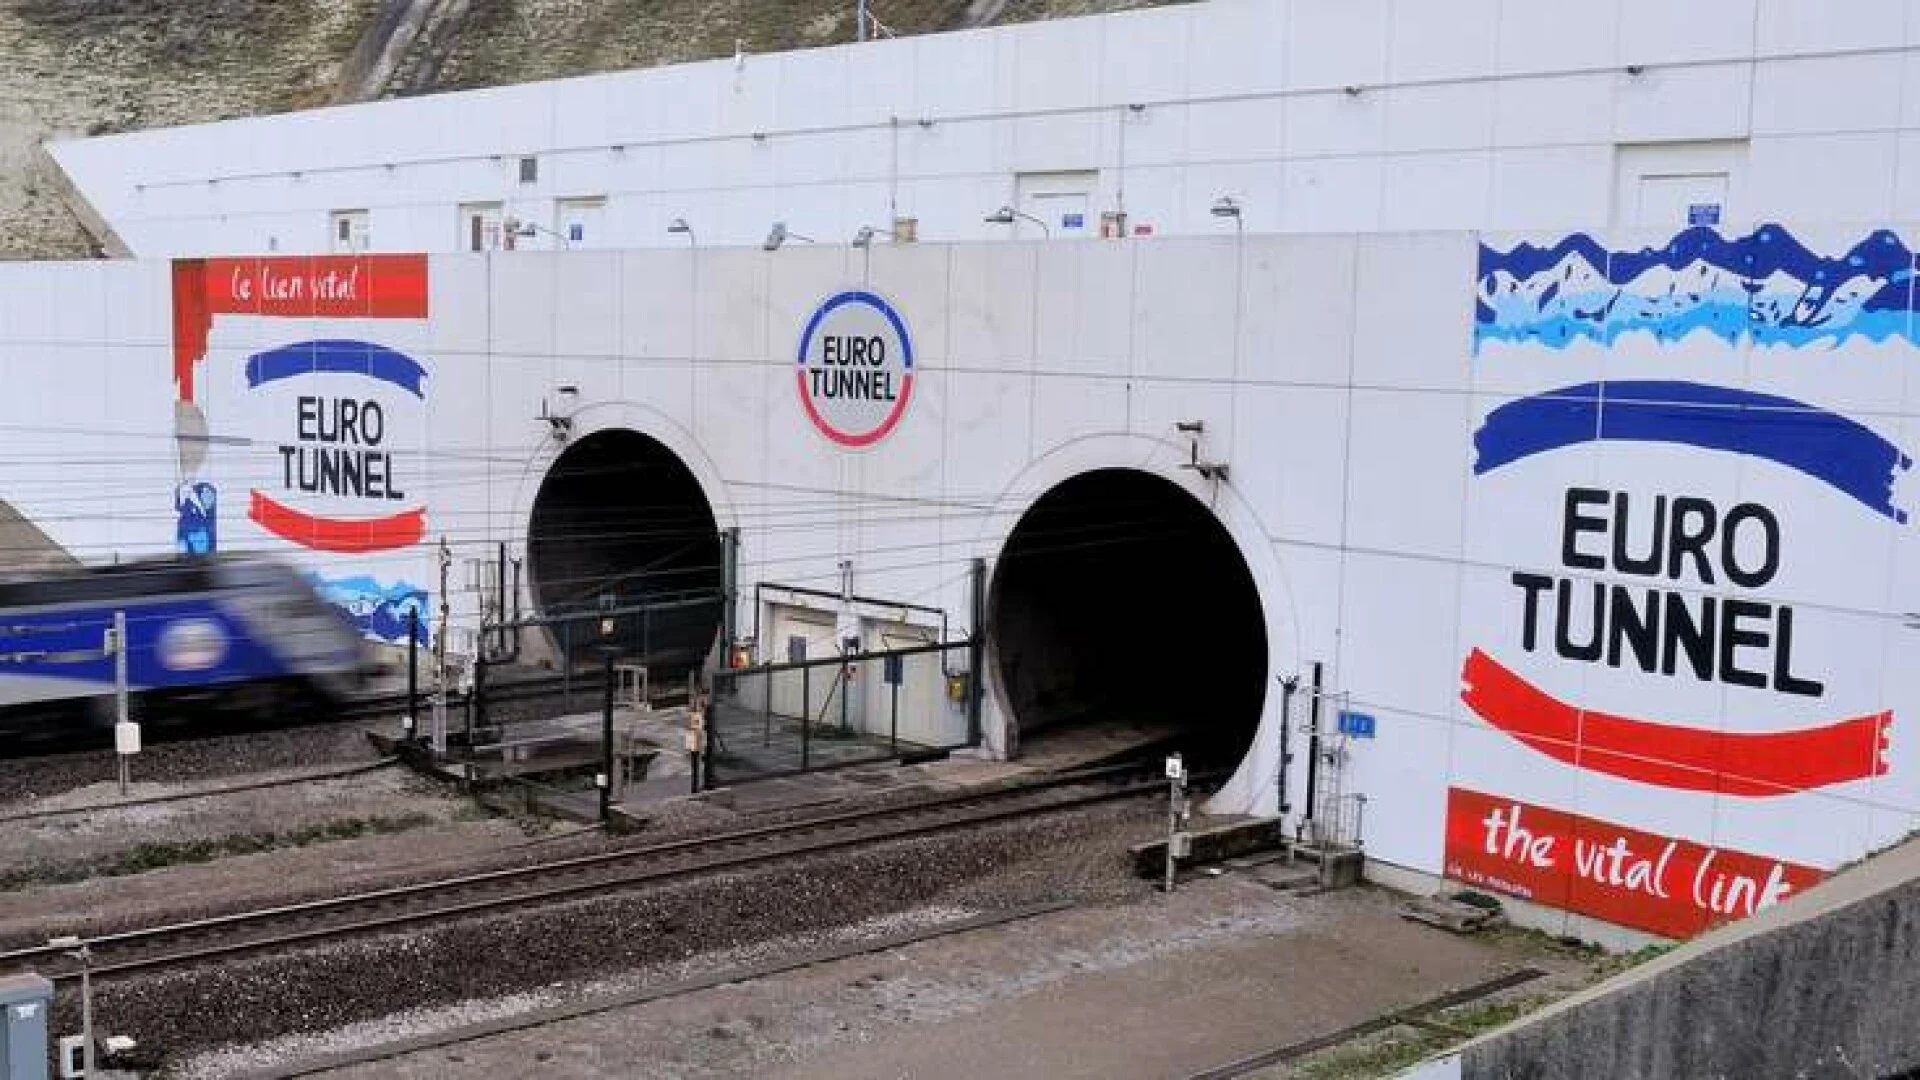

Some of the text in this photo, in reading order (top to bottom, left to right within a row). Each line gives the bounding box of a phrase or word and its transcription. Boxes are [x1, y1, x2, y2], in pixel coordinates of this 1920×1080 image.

[231, 263, 358, 301] le lien vital
[823, 335, 885, 367] EURO
[810, 366, 896, 402] TUNNEL
[298, 396, 383, 447] EURO
[278, 445, 405, 500] TUNNEL
[1562, 487, 1780, 588] EURO
[1512, 572, 1824, 698] TUNNEL
[1482, 805, 1556, 867] the
[1574, 837, 1678, 898] vital
[1692, 849, 1792, 918] link
